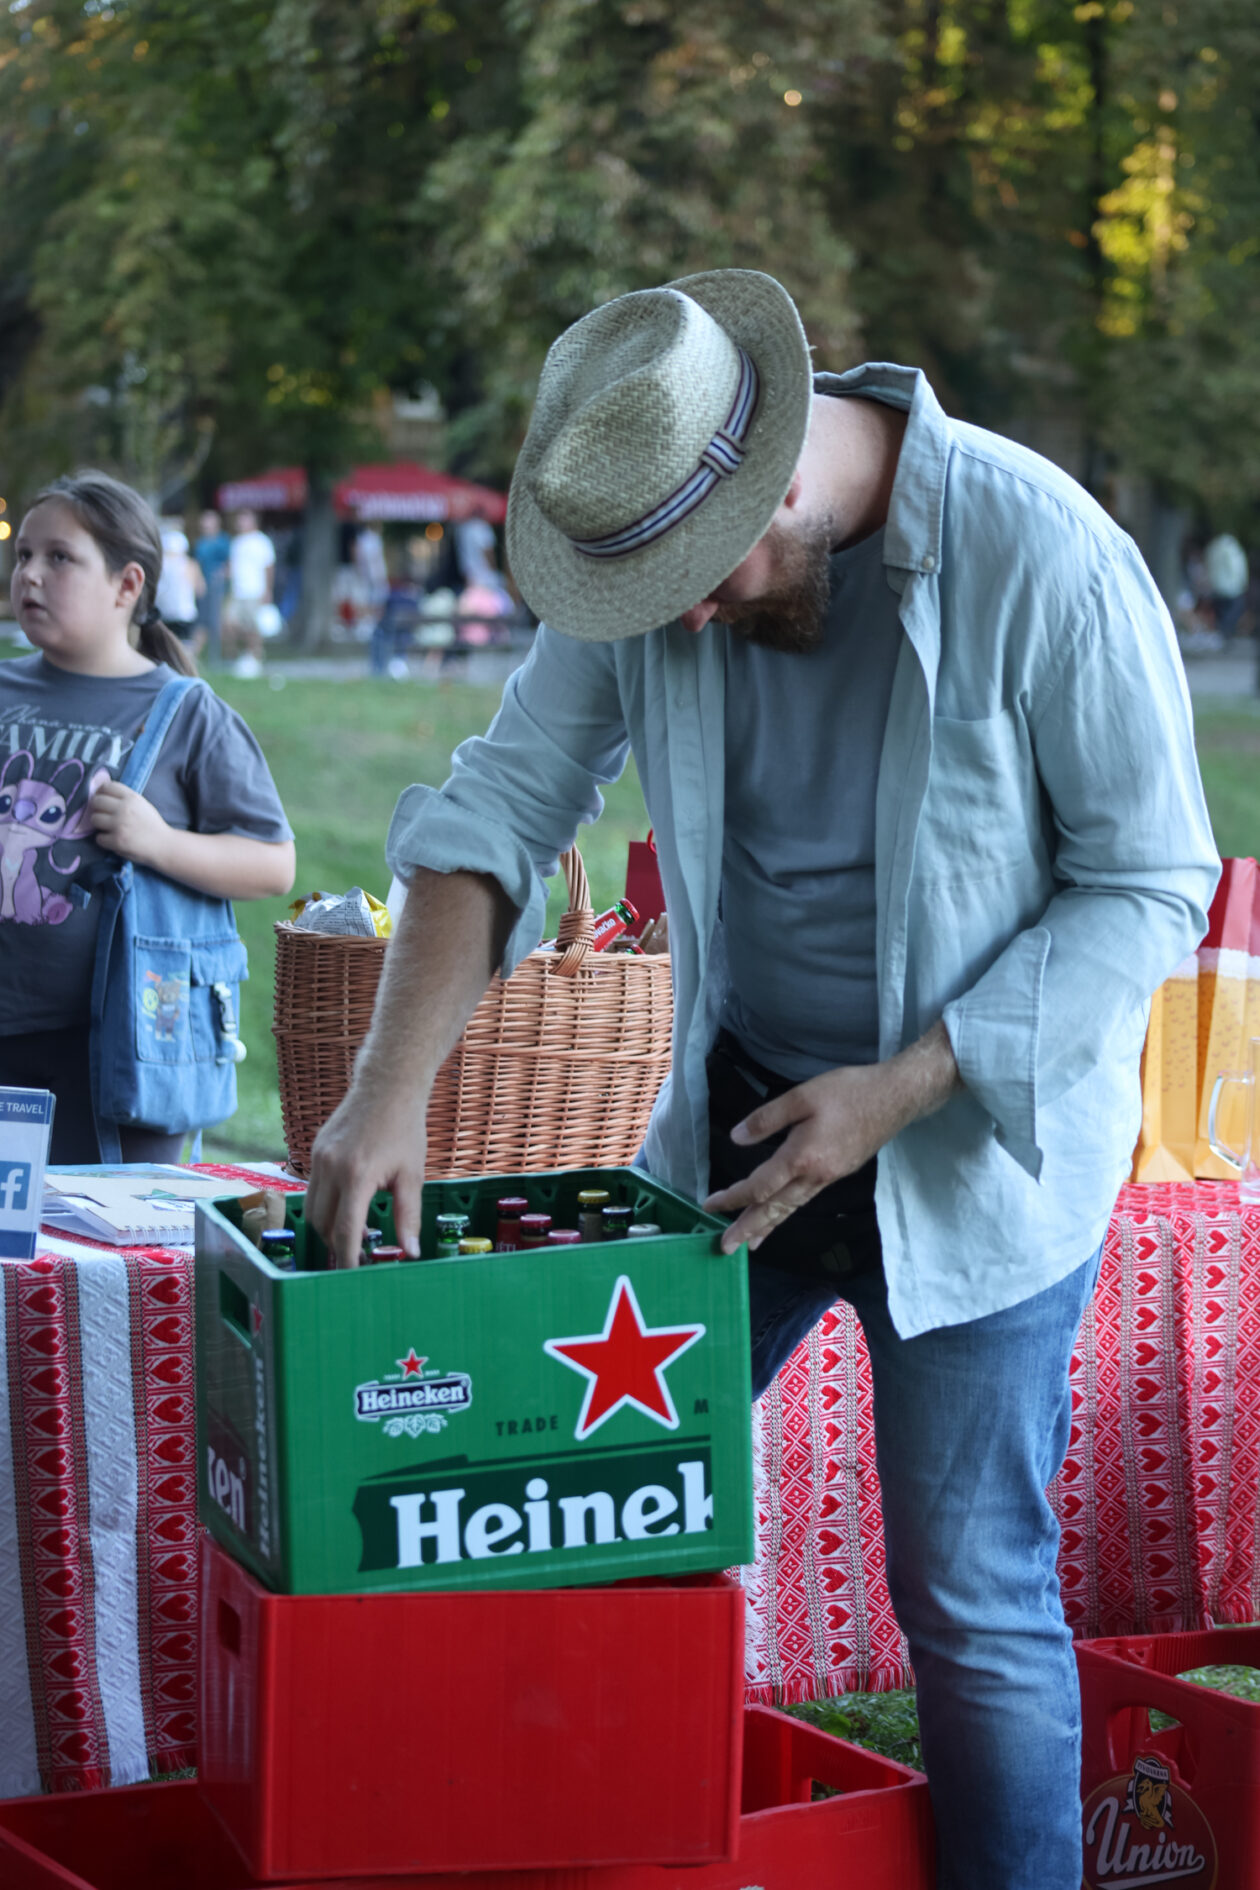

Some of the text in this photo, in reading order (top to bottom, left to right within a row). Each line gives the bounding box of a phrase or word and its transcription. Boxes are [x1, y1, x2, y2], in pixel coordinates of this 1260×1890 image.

[0, 724, 134, 768] AMILY
[7, 1102, 44, 1114] TRAVEL
[361, 1382, 464, 1412] Heineken
[496, 1415, 558, 1436] TRADE
[1086, 1796, 1205, 1876] Union
